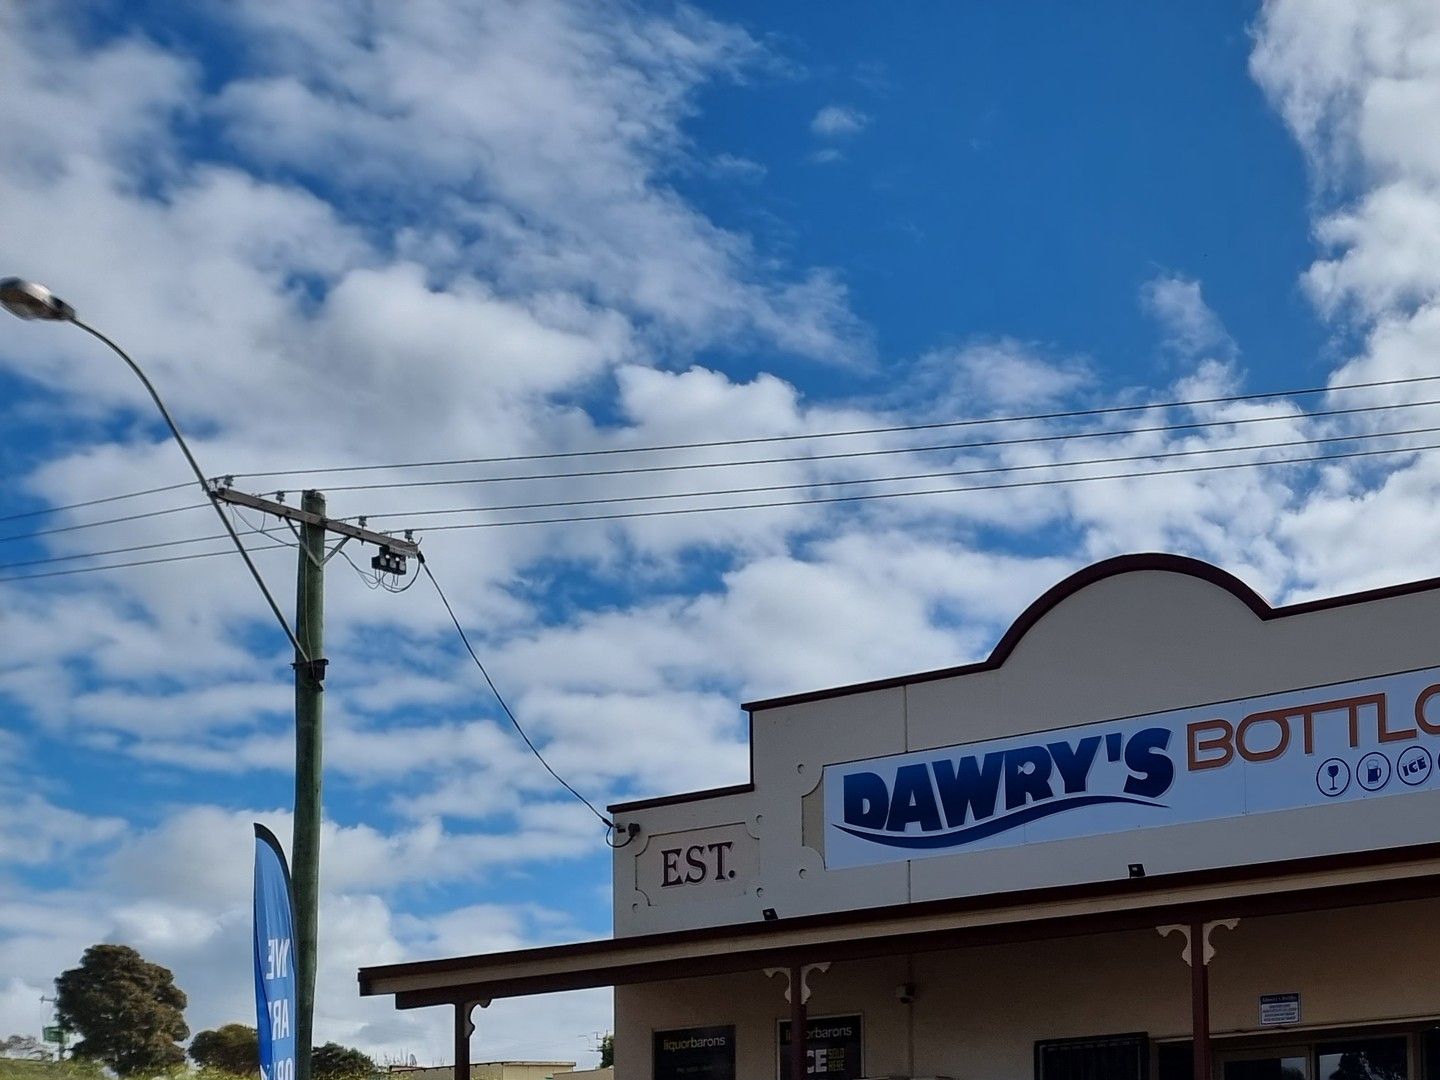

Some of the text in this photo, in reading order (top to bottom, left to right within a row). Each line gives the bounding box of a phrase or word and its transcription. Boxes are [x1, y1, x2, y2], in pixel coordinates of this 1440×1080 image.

[843, 726, 1174, 832] DAWRY'S
[1402, 756, 1427, 777] ICE
[660, 841, 736, 888] EST.
